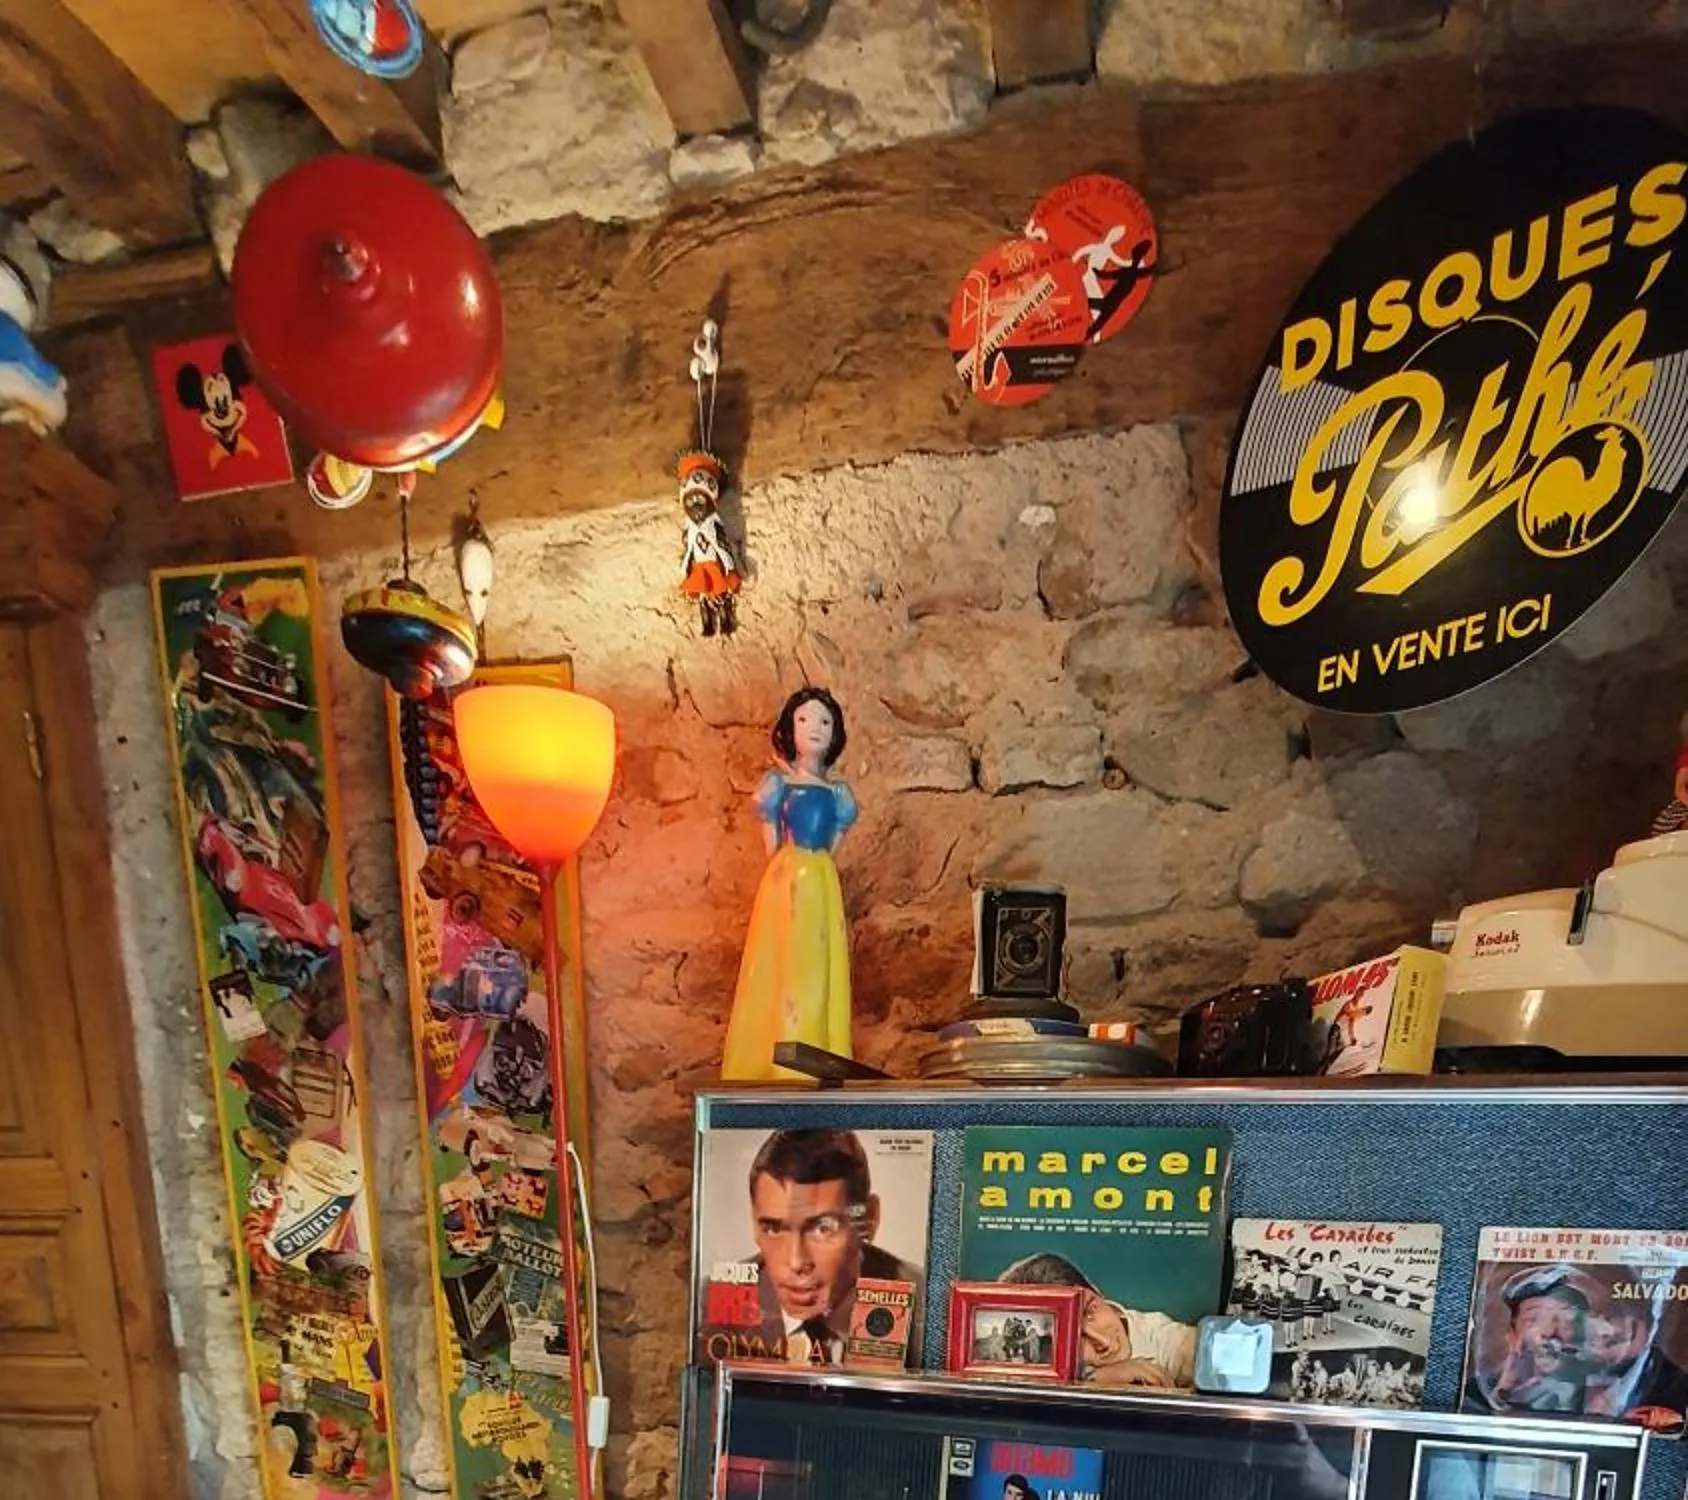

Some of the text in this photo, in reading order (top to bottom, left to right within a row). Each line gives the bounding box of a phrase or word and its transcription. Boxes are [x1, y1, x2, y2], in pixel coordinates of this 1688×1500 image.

[1280, 162, 1687, 395] DISQUES
[1257, 250, 1671, 627] Pathé
[1317, 594, 1550, 692] EN VENTE ICI
[1475, 929, 1519, 946] Kodak
[982, 1147, 1217, 1175] marcel
[979, 1185, 1213, 1213] amont
[291, 1203, 344, 1248] UNIFLO
[1264, 1221, 1295, 1241] Les
[1557, 1233, 1583, 1245] EST
[1494, 1247, 1537, 1259] TWIST
